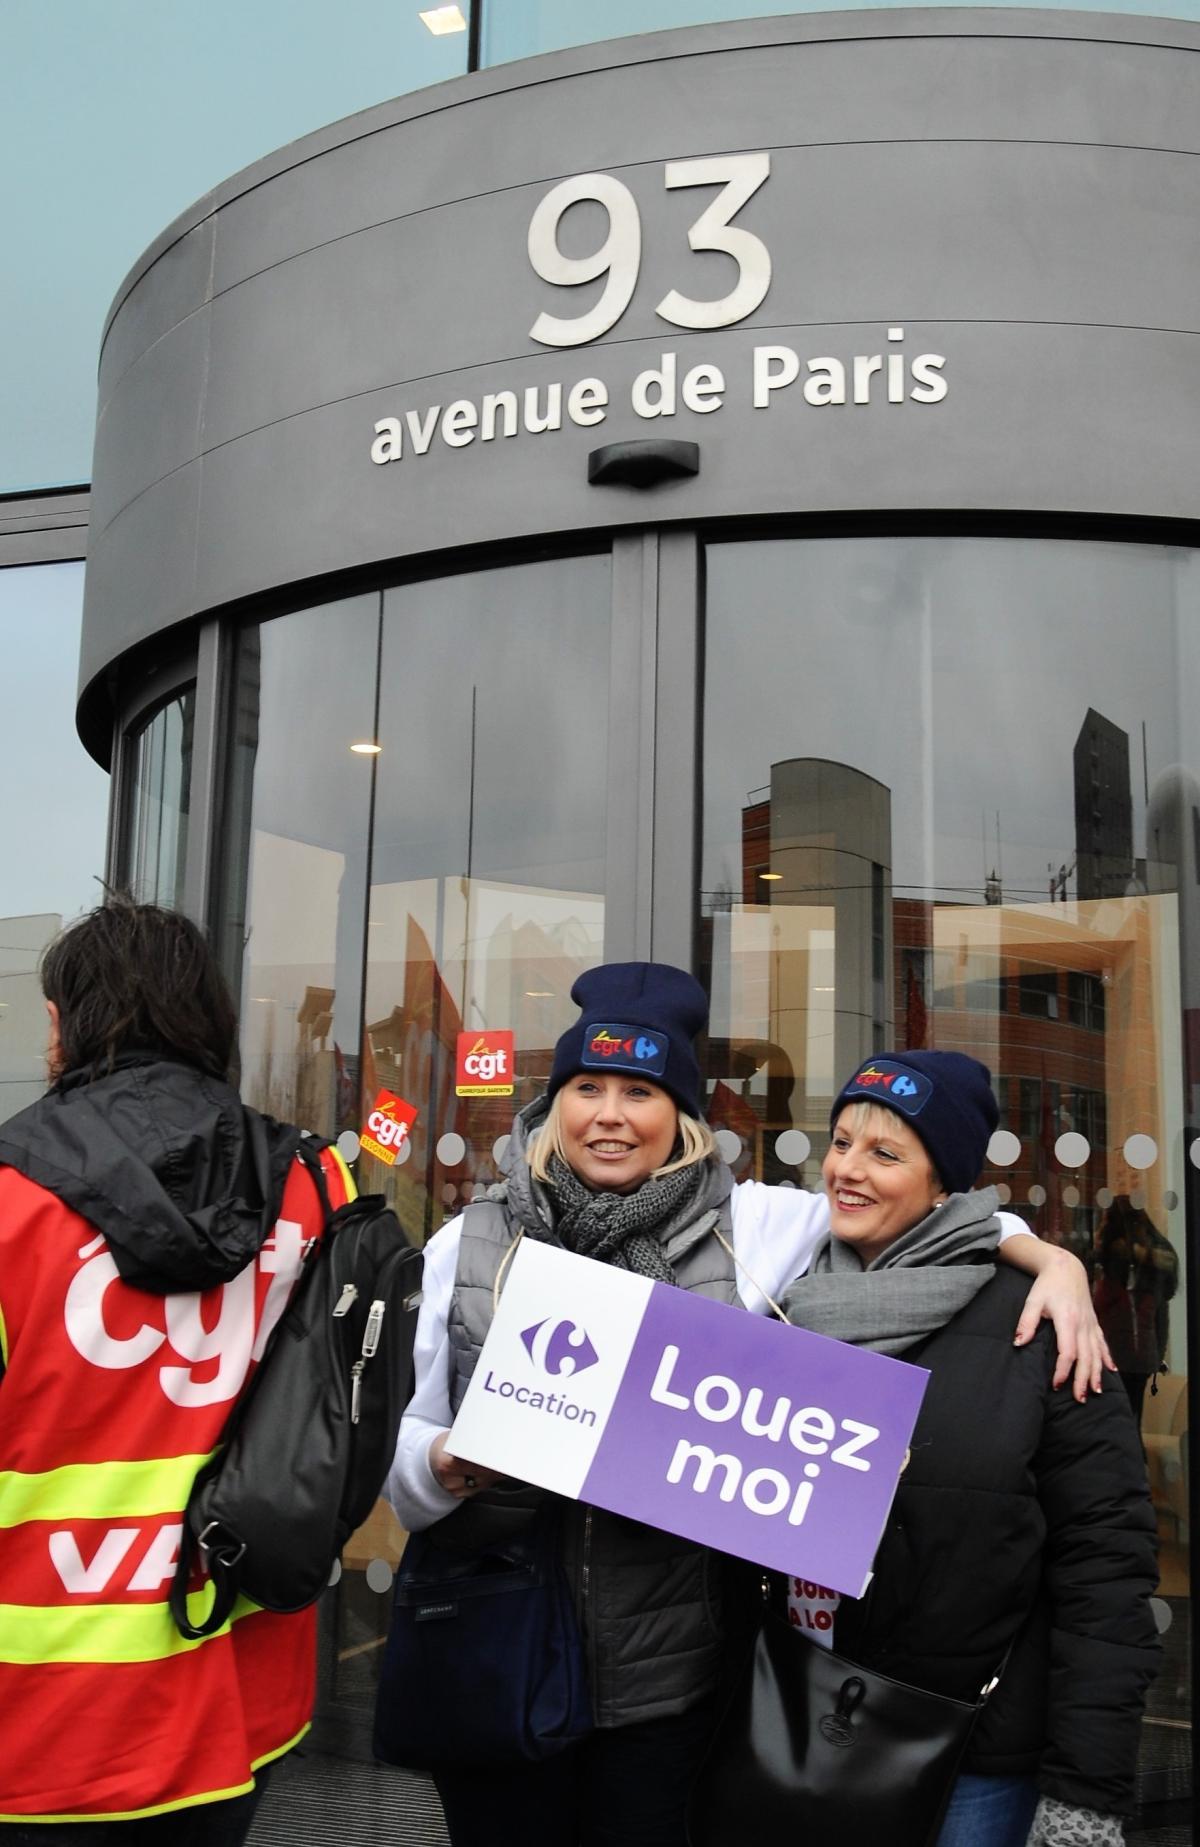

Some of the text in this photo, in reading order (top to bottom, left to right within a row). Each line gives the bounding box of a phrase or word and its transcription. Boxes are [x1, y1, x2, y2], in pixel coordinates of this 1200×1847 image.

[527, 153, 772, 347] 93
[370, 327, 949, 465] avenue de Paris
[464, 1049, 507, 1080] cgt
[467, 1038, 498, 1056] la
[590, 1040, 621, 1057] cgt
[367, 1111, 408, 1147] cgt
[375, 1101, 401, 1126] la
[64, 1219, 306, 1408] cgt
[483, 1371, 597, 1428] Location
[650, 1344, 880, 1472] Louez
[666, 1439, 820, 1526] moi
[49, 1524, 208, 1593] VA
